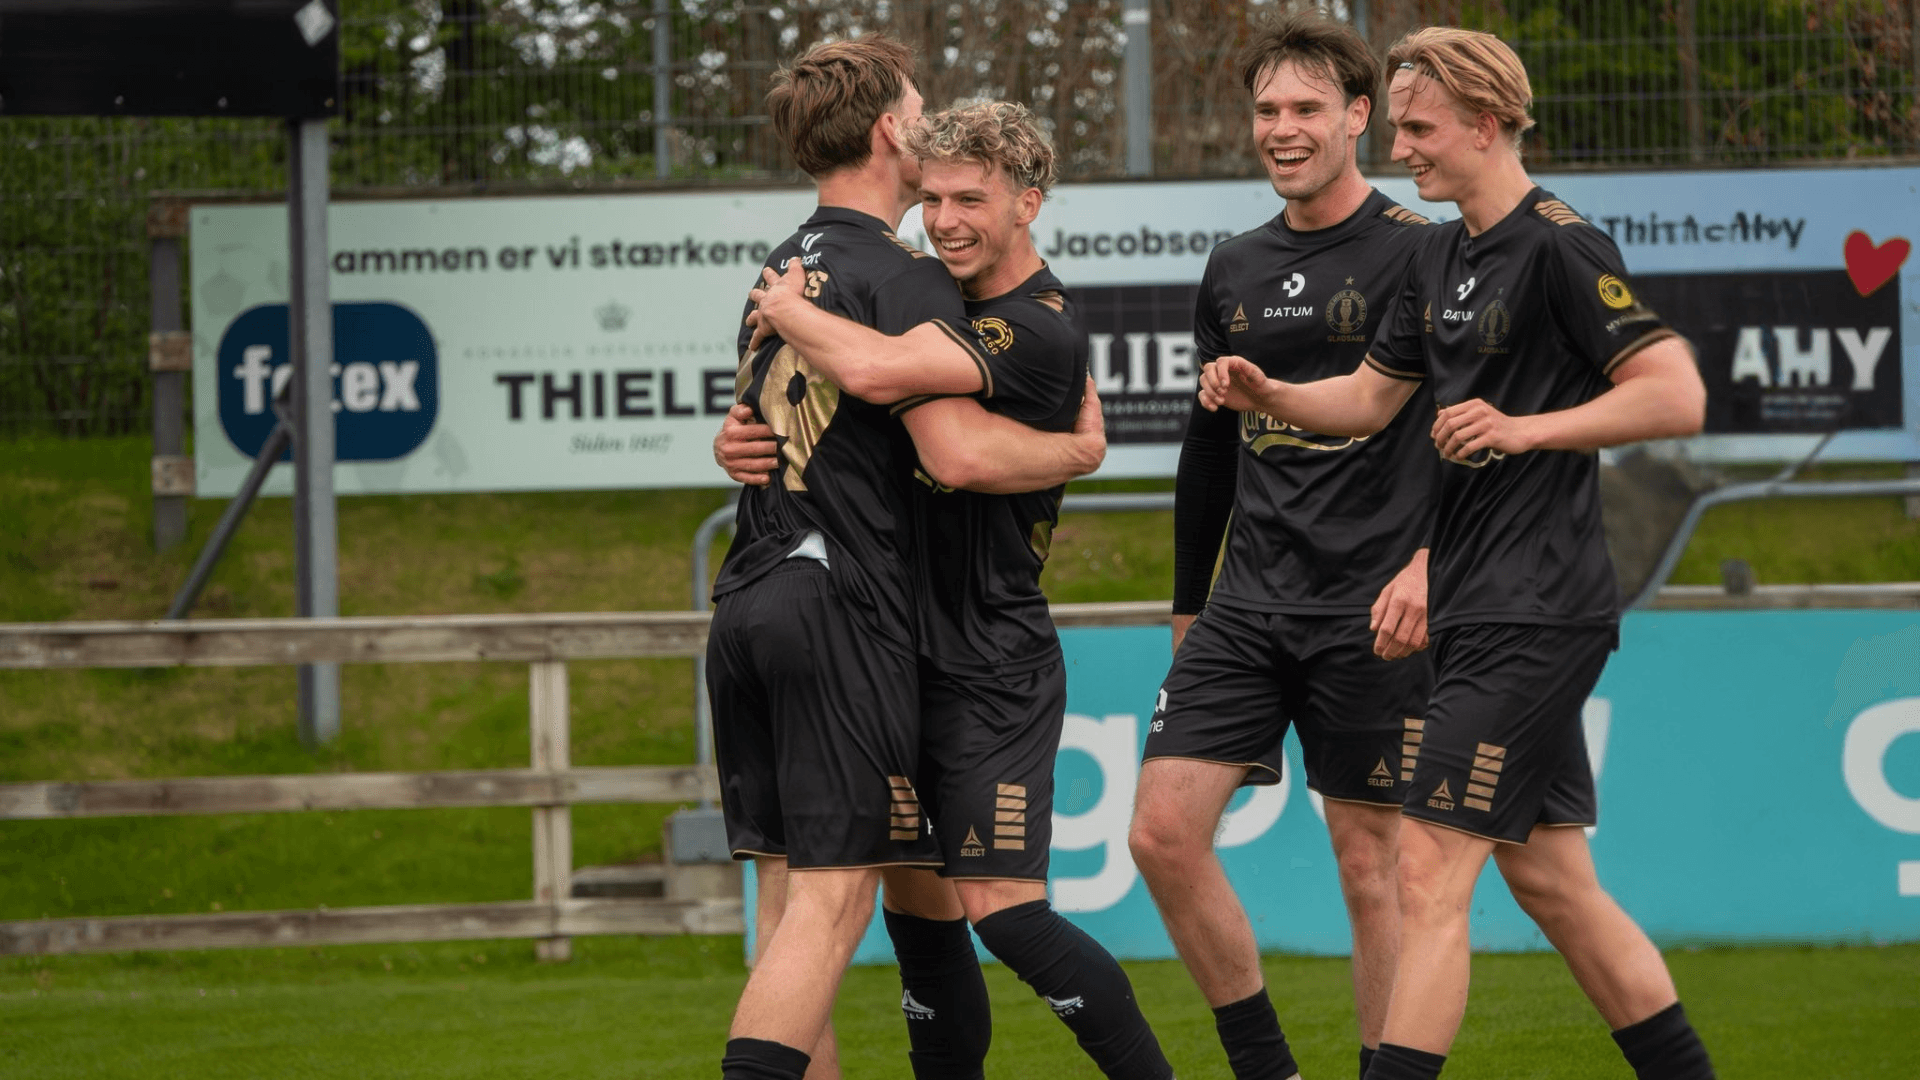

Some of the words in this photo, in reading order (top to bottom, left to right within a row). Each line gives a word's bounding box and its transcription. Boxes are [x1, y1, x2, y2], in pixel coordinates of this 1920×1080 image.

[331, 248, 489, 274] ammen
[498, 246, 539, 271] er
[547, 235, 580, 269] vi
[589, 235, 771, 269] stærkere
[1263, 306, 1313, 318] DATUM
[1229, 322, 1250, 333] SELECT
[232, 343, 422, 416] fex
[493, 368, 739, 422] THIELE
[1367, 777, 1394, 788] SELECT
[1427, 798, 1456, 811] SELECT
[960, 848, 985, 857] SELECT
